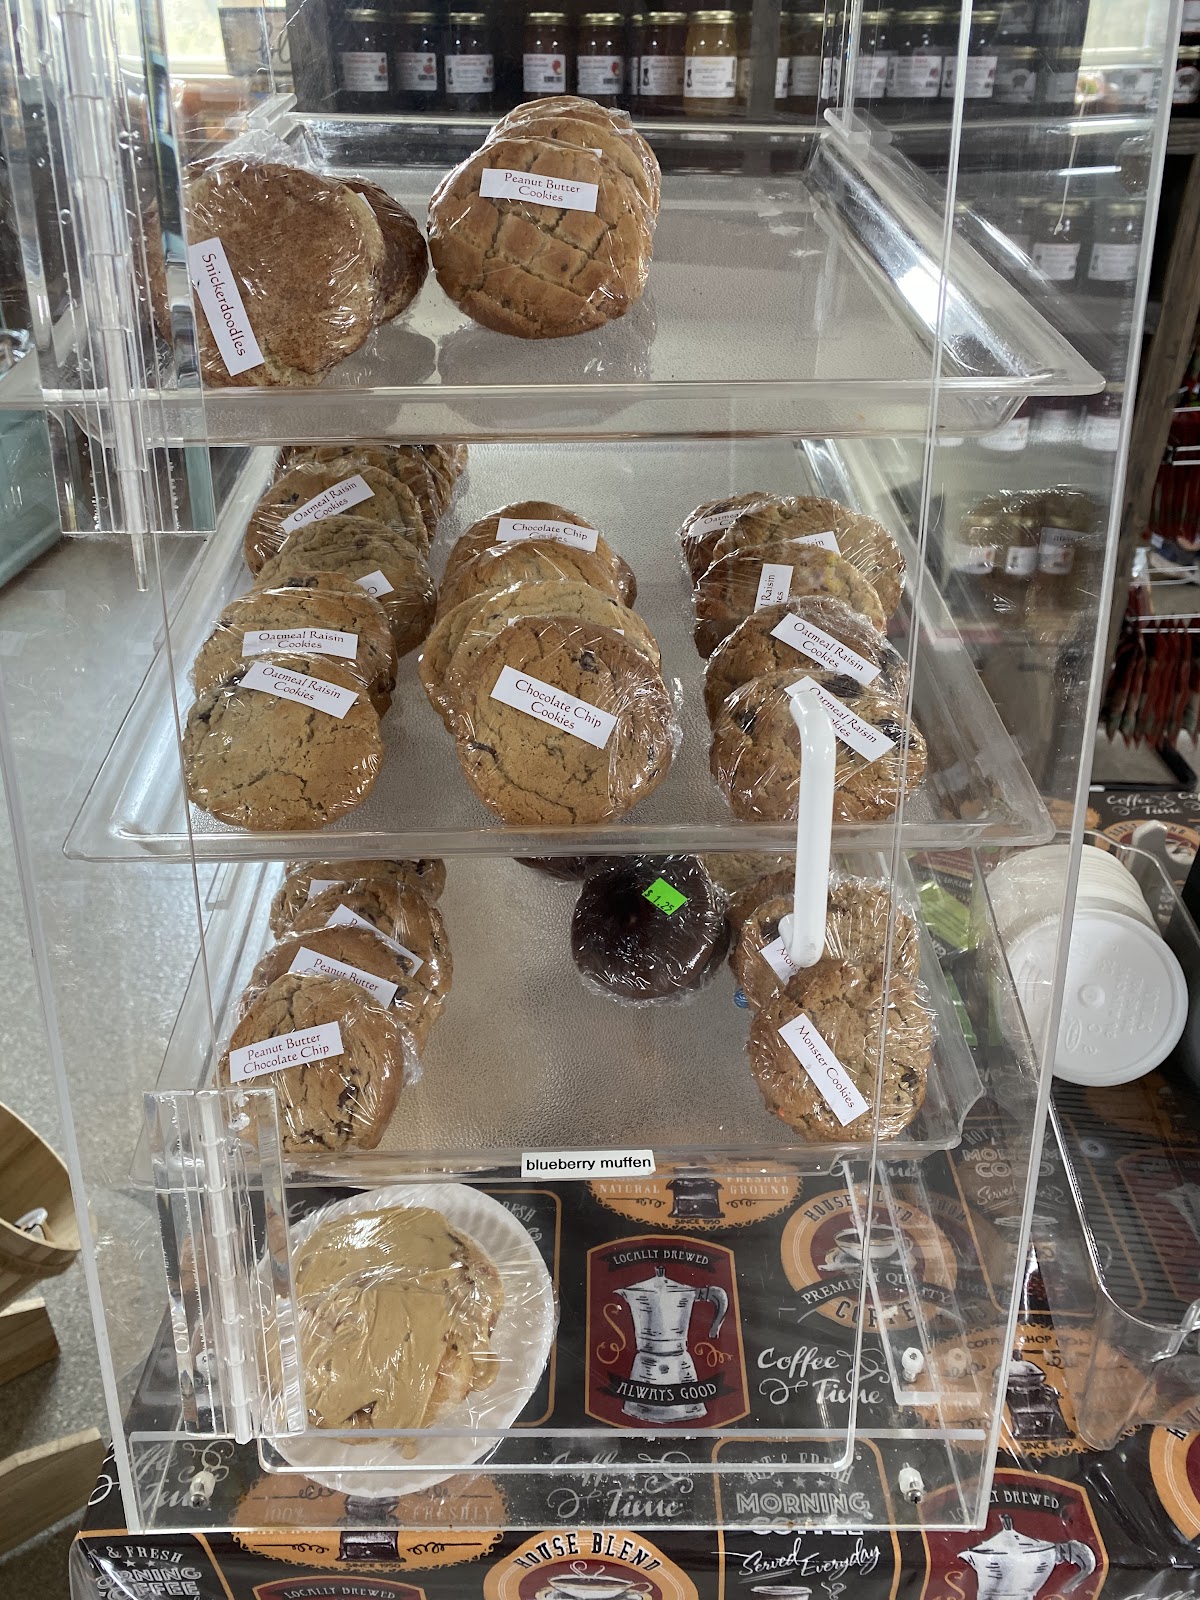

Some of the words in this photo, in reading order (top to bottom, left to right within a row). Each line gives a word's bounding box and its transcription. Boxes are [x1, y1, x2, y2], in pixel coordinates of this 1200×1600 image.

[504, 172, 542, 188] Peanut
[546, 180, 581, 193] Butter
[518, 186, 564, 202] Cookies
[202, 253, 246, 357] Snickerdoodles
[293, 490, 329, 522] Oatmeal
[329, 481, 357, 502] Raisin
[313, 497, 349, 521] Cookies
[704, 513, 740, 525] Oatmea
[512, 523, 561, 533] Chocolate
[563, 527, 588, 540] Chip
[761, 574, 776, 601] Raisin
[258, 630, 307, 642] Oatmeal
[309, 630, 345, 643] Raisin
[277, 640, 323, 650] Cookies
[793, 621, 835, 652] Oatmeal
[834, 647, 865, 672] Raisin
[802, 640, 840, 669] Cookies
[262, 667, 306, 687] Oatmeal
[306, 679, 342, 699] Raisin
[273, 681, 315, 702] Cookies
[515, 679, 572, 712] Chocolate
[574, 706, 602, 729] Chip
[530, 701, 576, 730] Cookies
[848, 718, 877, 743] Raisin
[313, 958, 347, 978] Peanut
[349, 972, 379, 992] Butter
[247, 1043, 283, 1061] Peanut
[286, 1033, 321, 1050] Butter
[243, 1053, 299, 1074] Chocolate
[300, 1044, 330, 1059] Chip
[795, 1025, 828, 1067] Monster
[826, 1067, 855, 1109] Cookies
[526, 1158, 596, 1171] blueberry
[600, 1157, 651, 1168] muffen
[600, 1184, 660, 1194] NATURAL
[730, 1185, 789, 1195] GROUND
[503, 1201, 537, 1223] RESH
[804, 1193, 853, 1222] HOUSE
[613, 1249, 659, 1265] LOCALLY
[663, 1249, 709, 1265] BREWED
[757, 1345, 840, 1379] Coffee
[616, 1382, 675, 1402] ALWAYS
[680, 1383, 717, 1400] GOOD
[1020, 1441, 1049, 1450] SINCE
[606, 1488, 683, 1518] Time
[736, 1492, 871, 1514] MORNING
[1003, 1490, 1060, 1510] BREWED
[106, 1545, 122, 1559] &
[124, 1545, 184, 1564] FRESH
[513, 1532, 580, 1570] HOUSE
[590, 1531, 664, 1571] BLEND
[739, 1537, 801, 1577] Served
[801, 1537, 881, 1582] Everyday
[96, 1567, 203, 1590] ORNING
[284, 1586, 336, 1599] LOCALLY
[341, 1586, 396, 1599] BREWED
